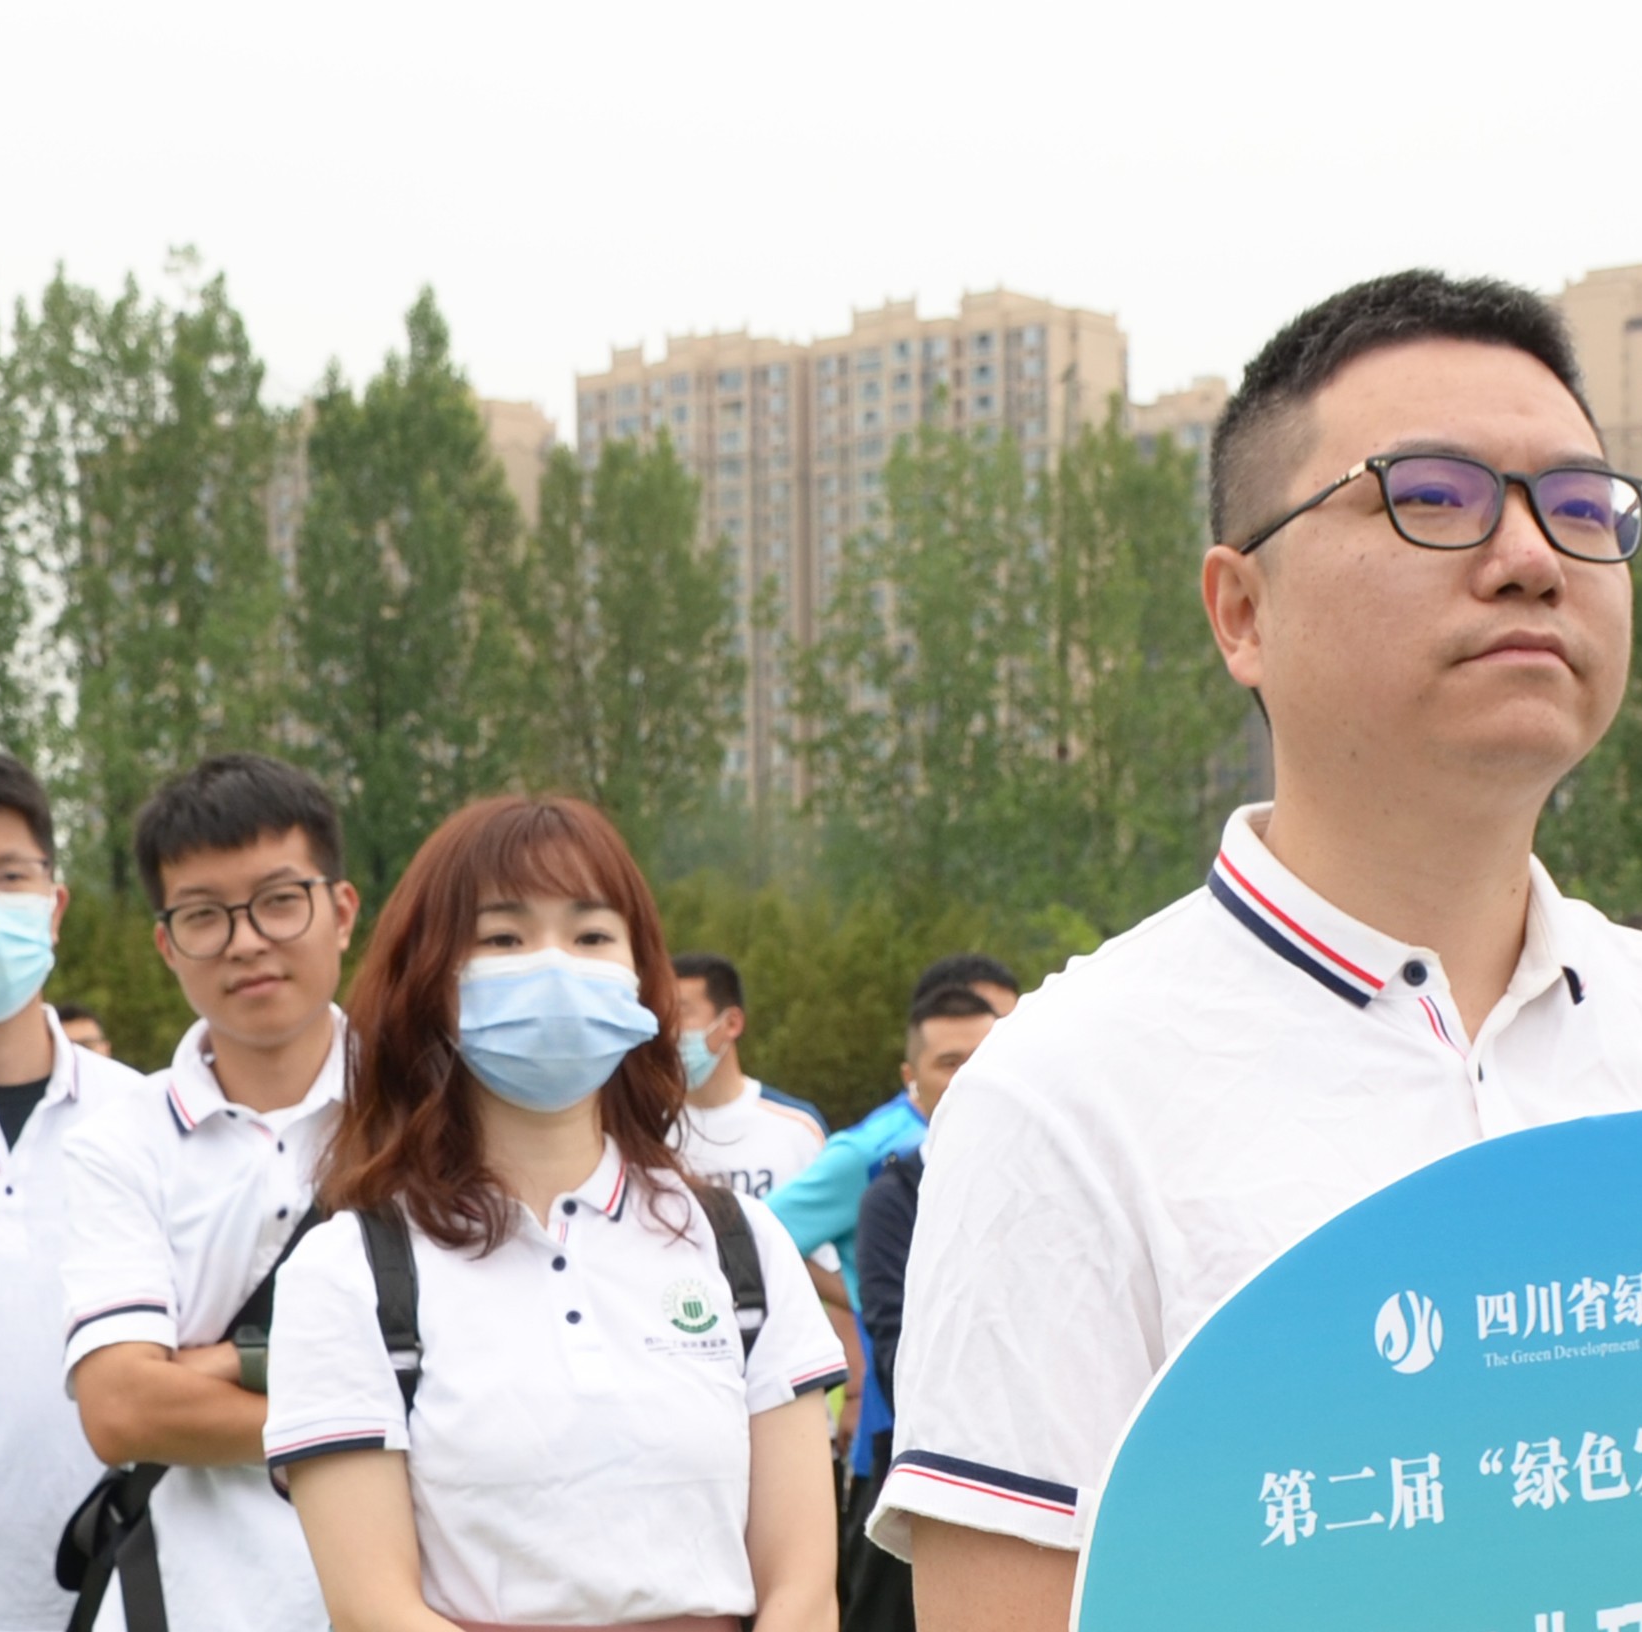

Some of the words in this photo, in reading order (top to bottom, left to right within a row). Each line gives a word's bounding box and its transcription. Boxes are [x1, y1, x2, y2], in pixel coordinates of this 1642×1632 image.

[1483, 1351, 1509, 1368] The
[1512, 1348, 1552, 1365] Green
[1555, 1340, 1640, 1360] Development
